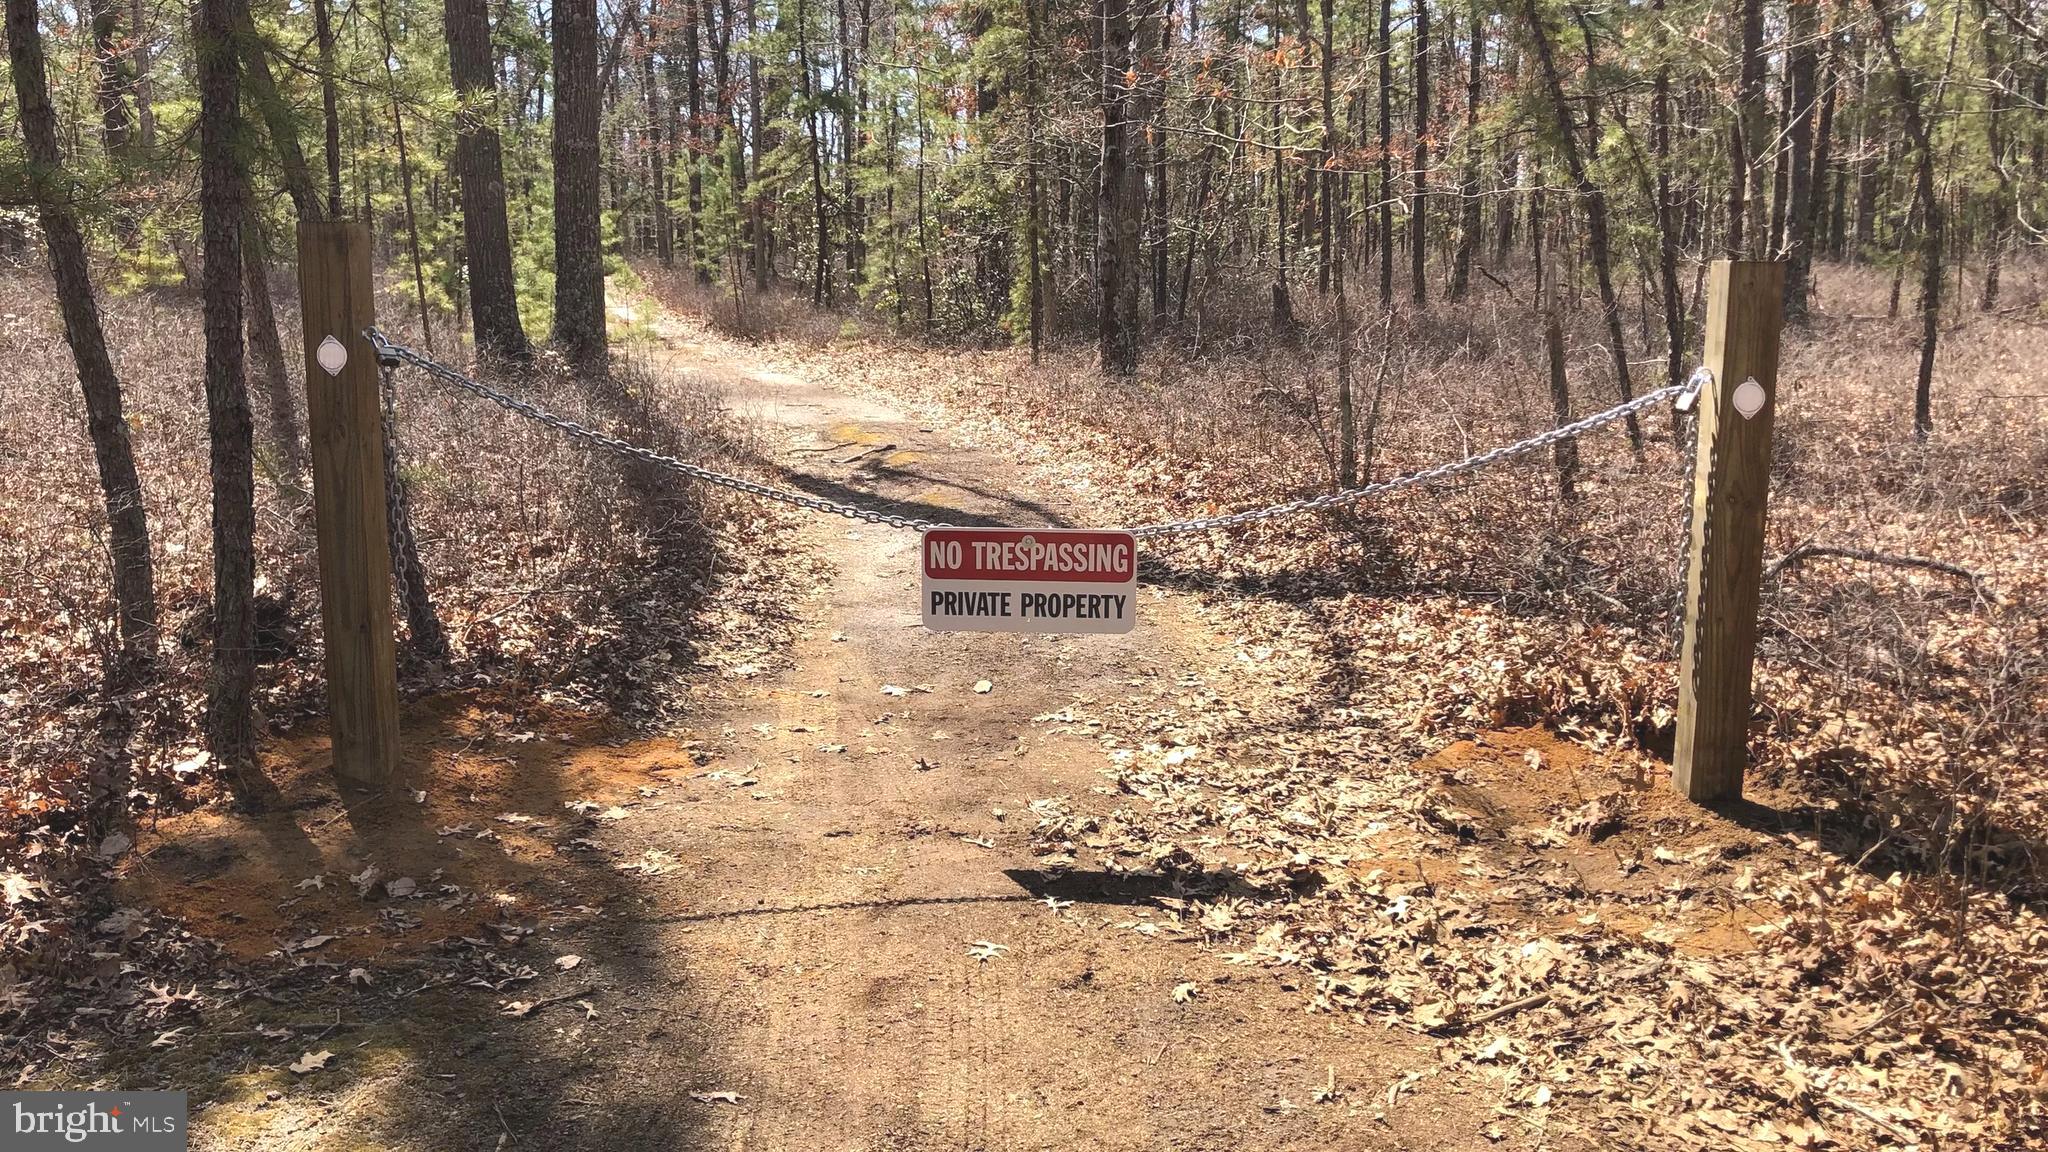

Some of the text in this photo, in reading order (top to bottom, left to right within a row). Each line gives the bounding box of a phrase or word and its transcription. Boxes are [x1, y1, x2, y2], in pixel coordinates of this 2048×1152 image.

[930, 541, 1128, 573] NO TRESPASSING
[931, 591, 1126, 619] PRIVATE PROPERTY
